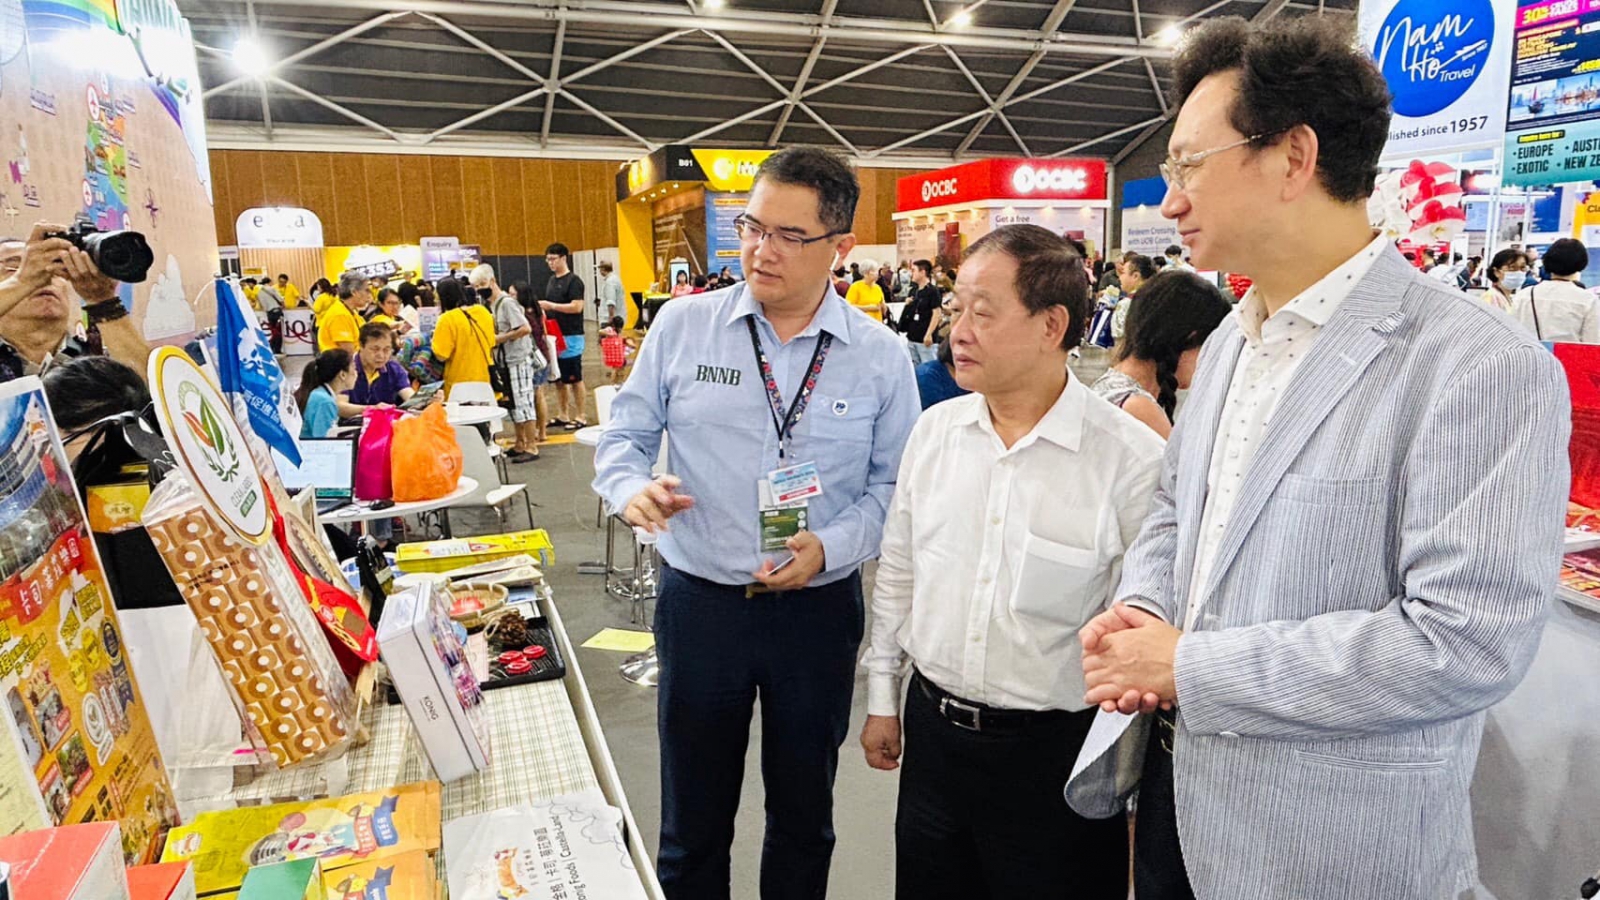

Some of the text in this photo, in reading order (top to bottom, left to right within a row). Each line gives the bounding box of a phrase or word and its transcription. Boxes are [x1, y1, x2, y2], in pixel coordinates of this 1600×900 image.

[1379, 14, 1474, 72] Nam
[1440, 64, 1476, 82] Travel
[1389, 115, 1489, 141] lished since 1957
[1518, 143, 1554, 159] EUROPE
[1516, 160, 1549, 175] EXOTIC
[1564, 155, 1587, 170] NEW
[931, 177, 957, 197] OCBC
[1034, 168, 1087, 191] OCBC
[995, 215, 1009, 223] Get
[1016, 215, 1030, 223] free
[695, 364, 742, 386] BNNB
[564, 862, 582, 885] Foods
